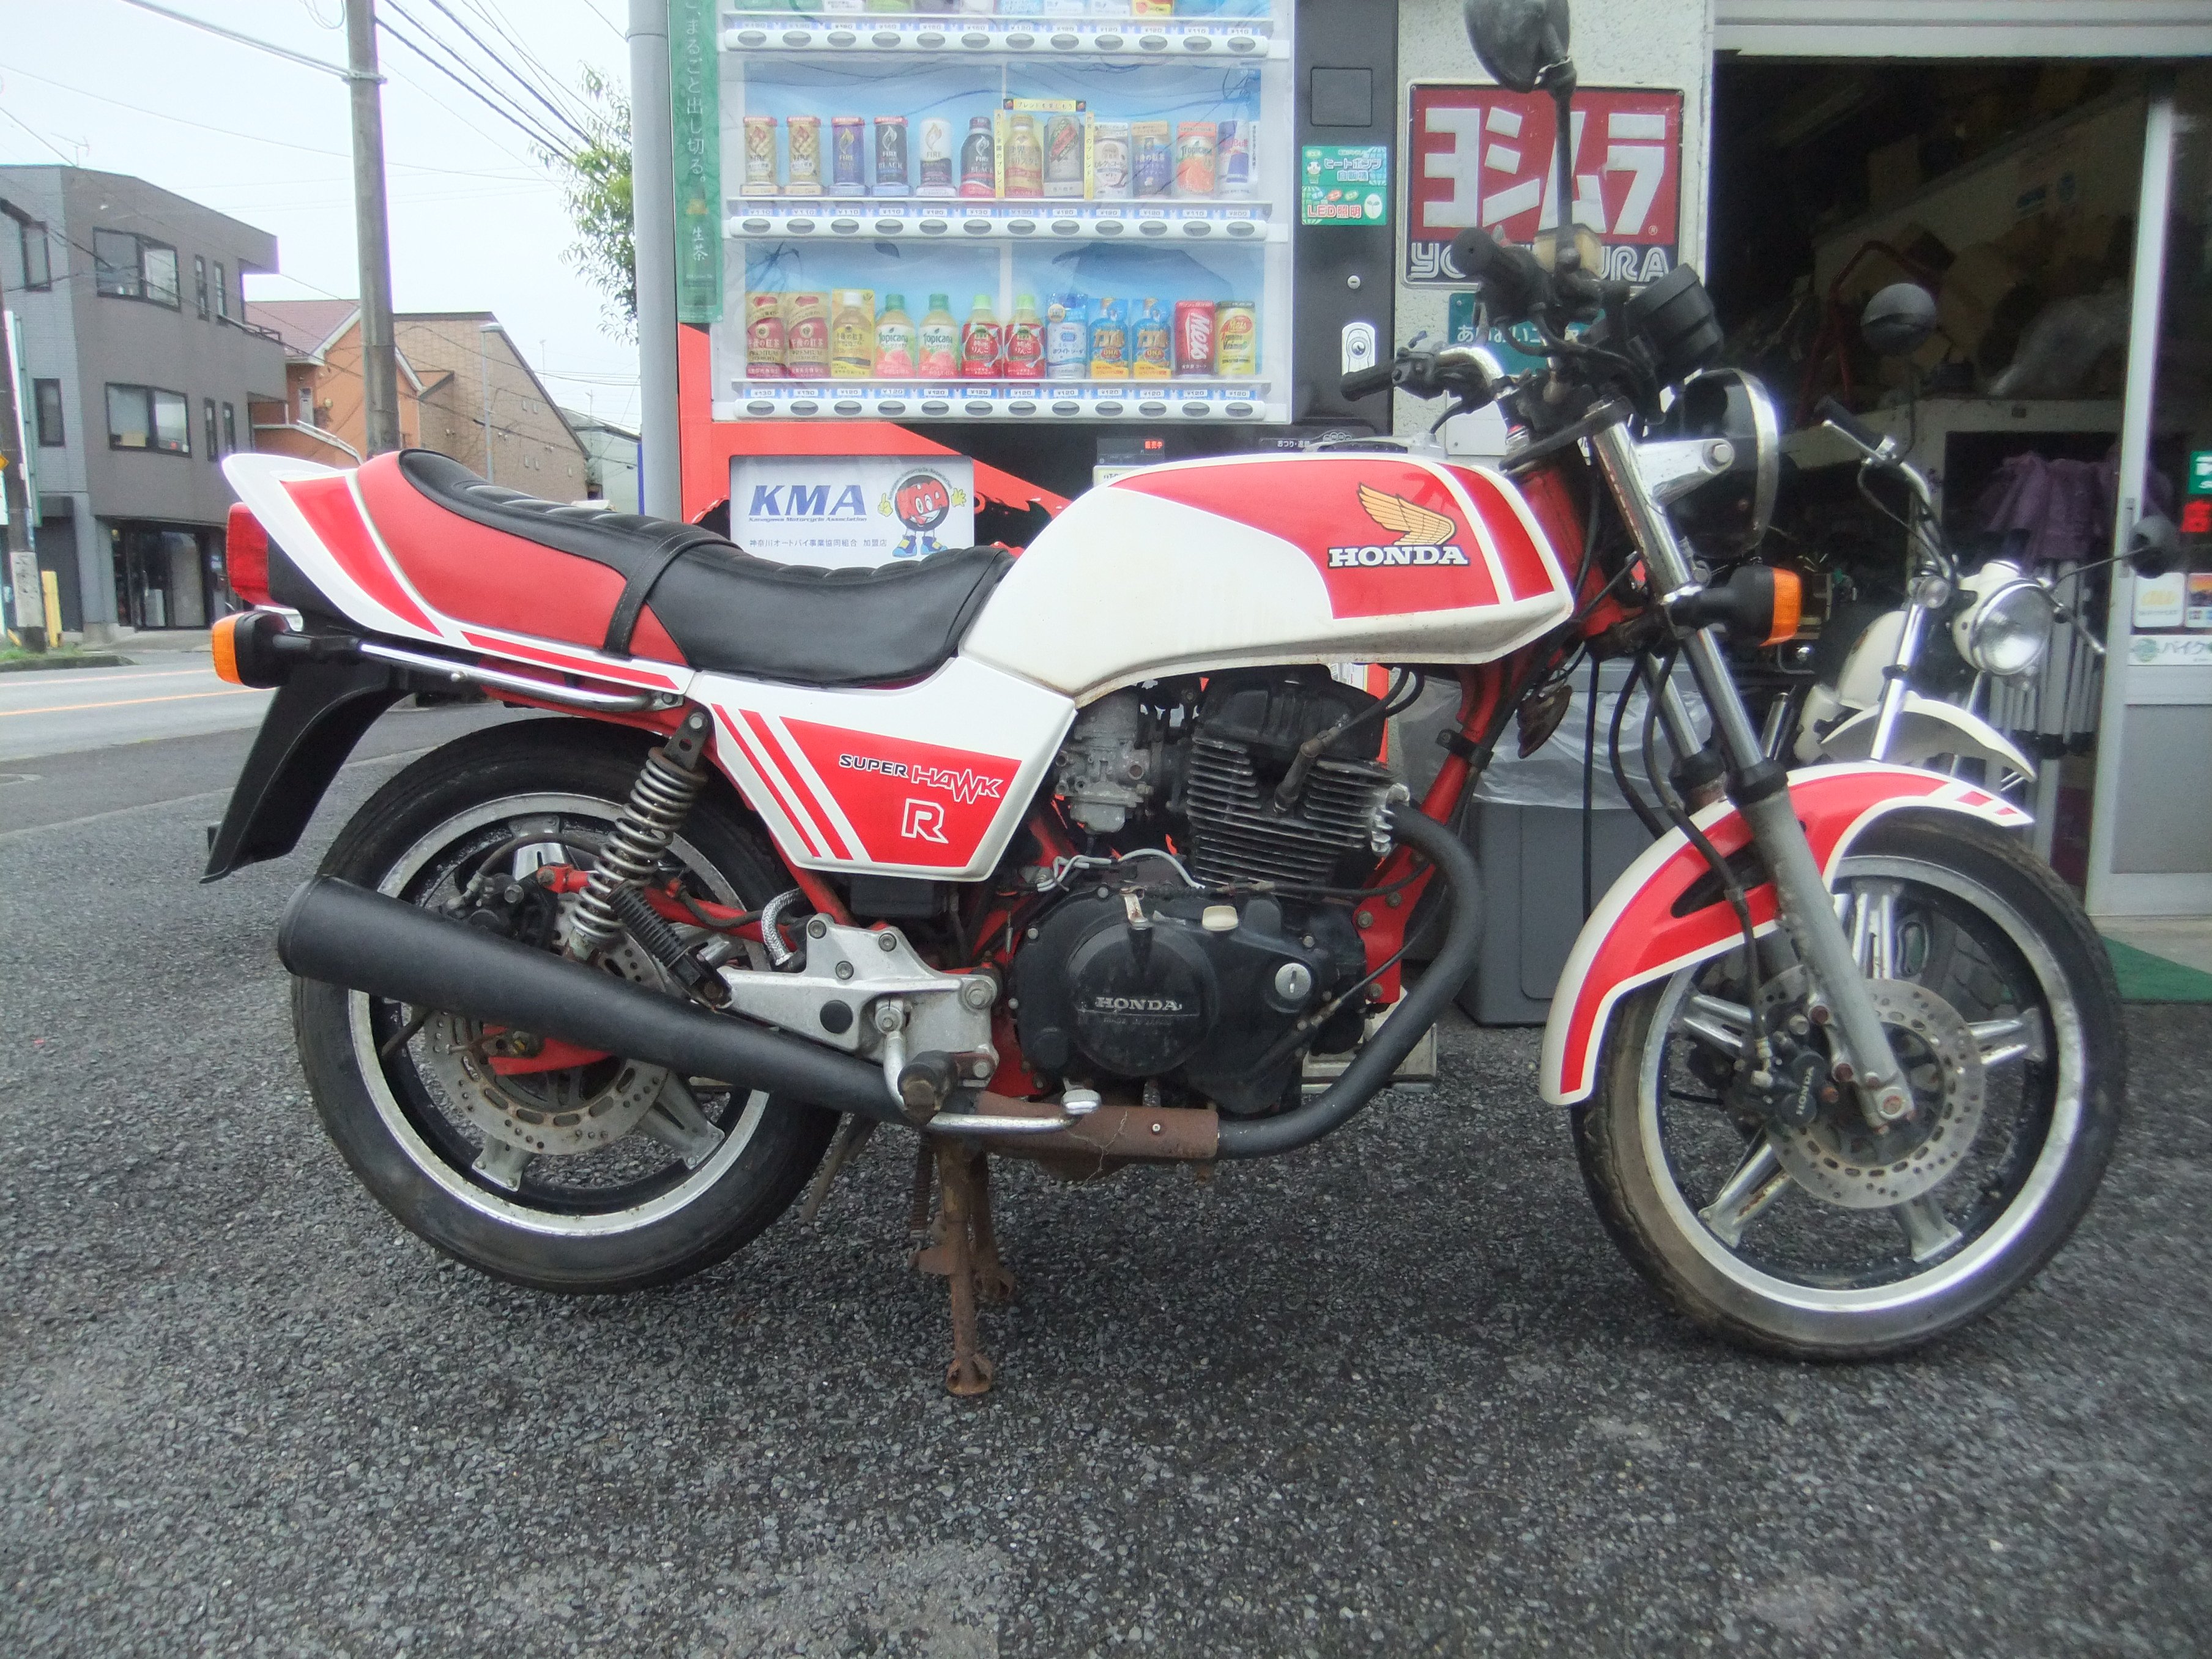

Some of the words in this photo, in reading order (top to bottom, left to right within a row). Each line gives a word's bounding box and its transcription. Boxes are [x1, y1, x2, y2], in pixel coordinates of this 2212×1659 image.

[1307, 204, 1362, 219] LED照明
[692, 226, 708, 261] 生茶
[748, 484, 867, 516] KMA
[749, 538, 858, 547] 神奈川オートバイ事業協同組合
[863, 538, 888, 547] 加盟店
[1327, 544, 1471, 568] HONDA
[838, 753, 910, 779] SUPER
[910, 764, 1004, 806] HAWK
[900, 797, 949, 845] R
[1095, 997, 1182, 1011] HONDA
